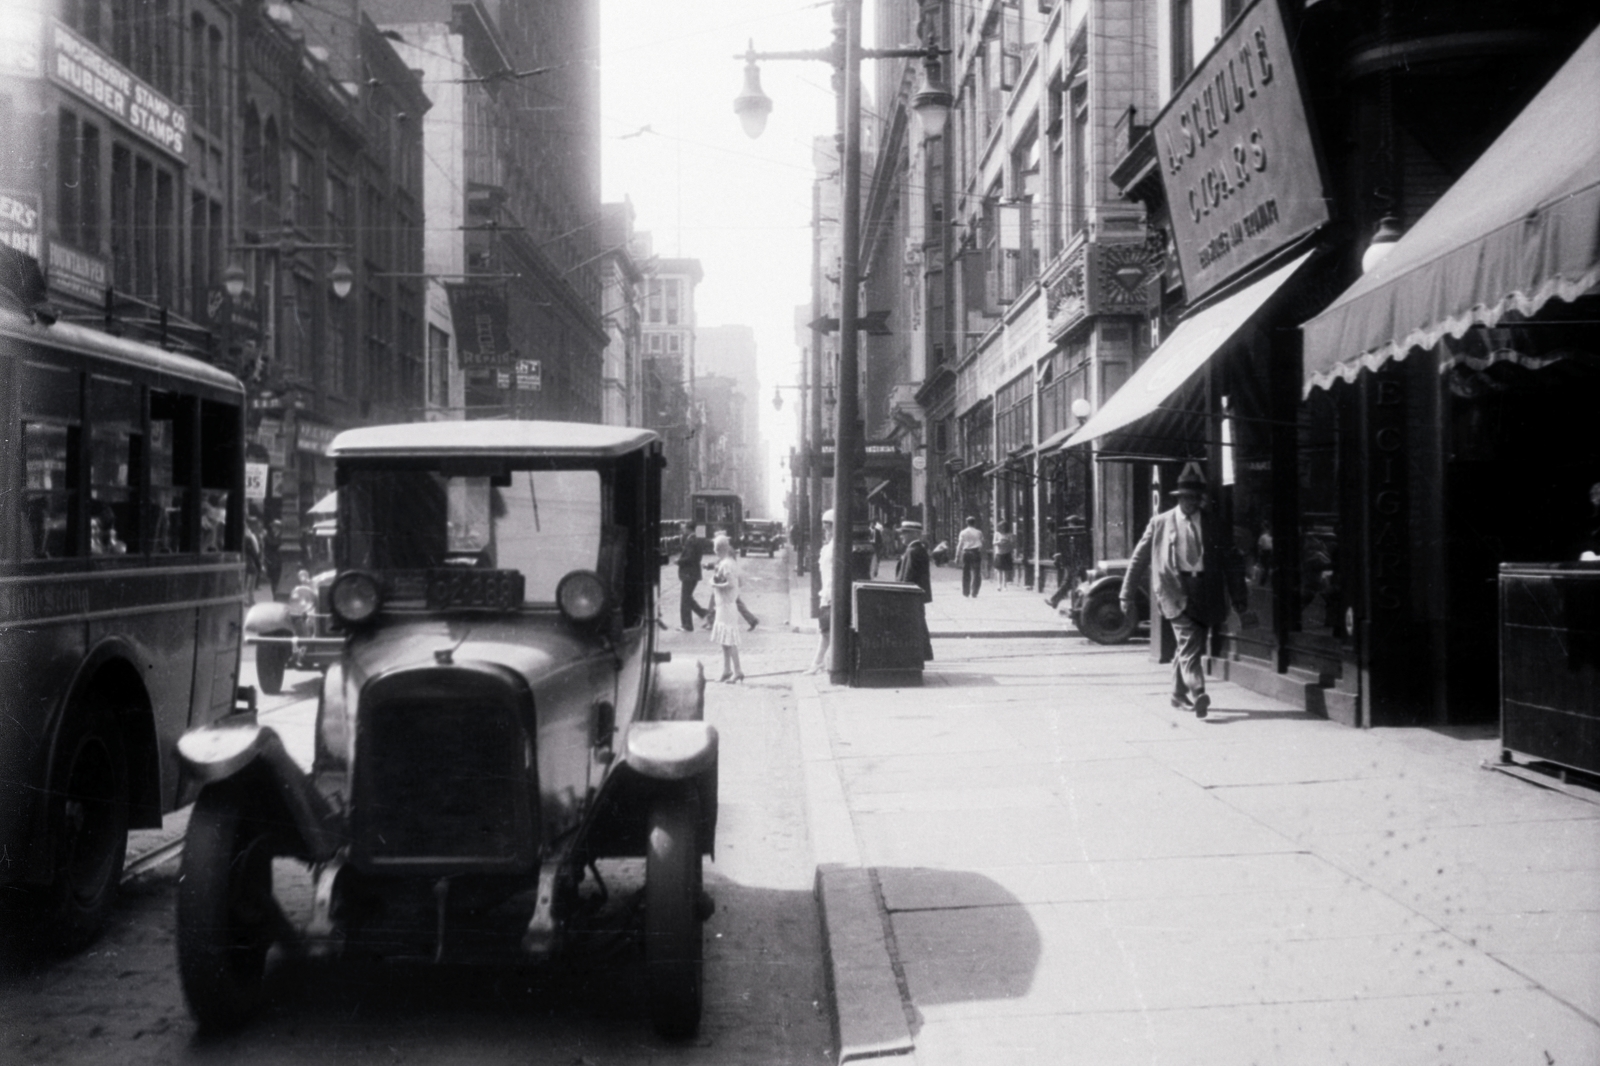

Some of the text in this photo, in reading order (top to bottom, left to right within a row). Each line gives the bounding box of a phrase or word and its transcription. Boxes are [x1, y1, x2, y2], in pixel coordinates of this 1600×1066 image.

[57, 52, 125, 116] RUBBER
[130, 103, 184, 153] STAMPS
[135, 84, 170, 119] STAMP
[1180, 26, 1274, 160] SCHULTE
[1189, 129, 1267, 223] CIGARS
[463, 349, 510, 364] REPAIR
[1375, 427, 1402, 610] CIGARS
